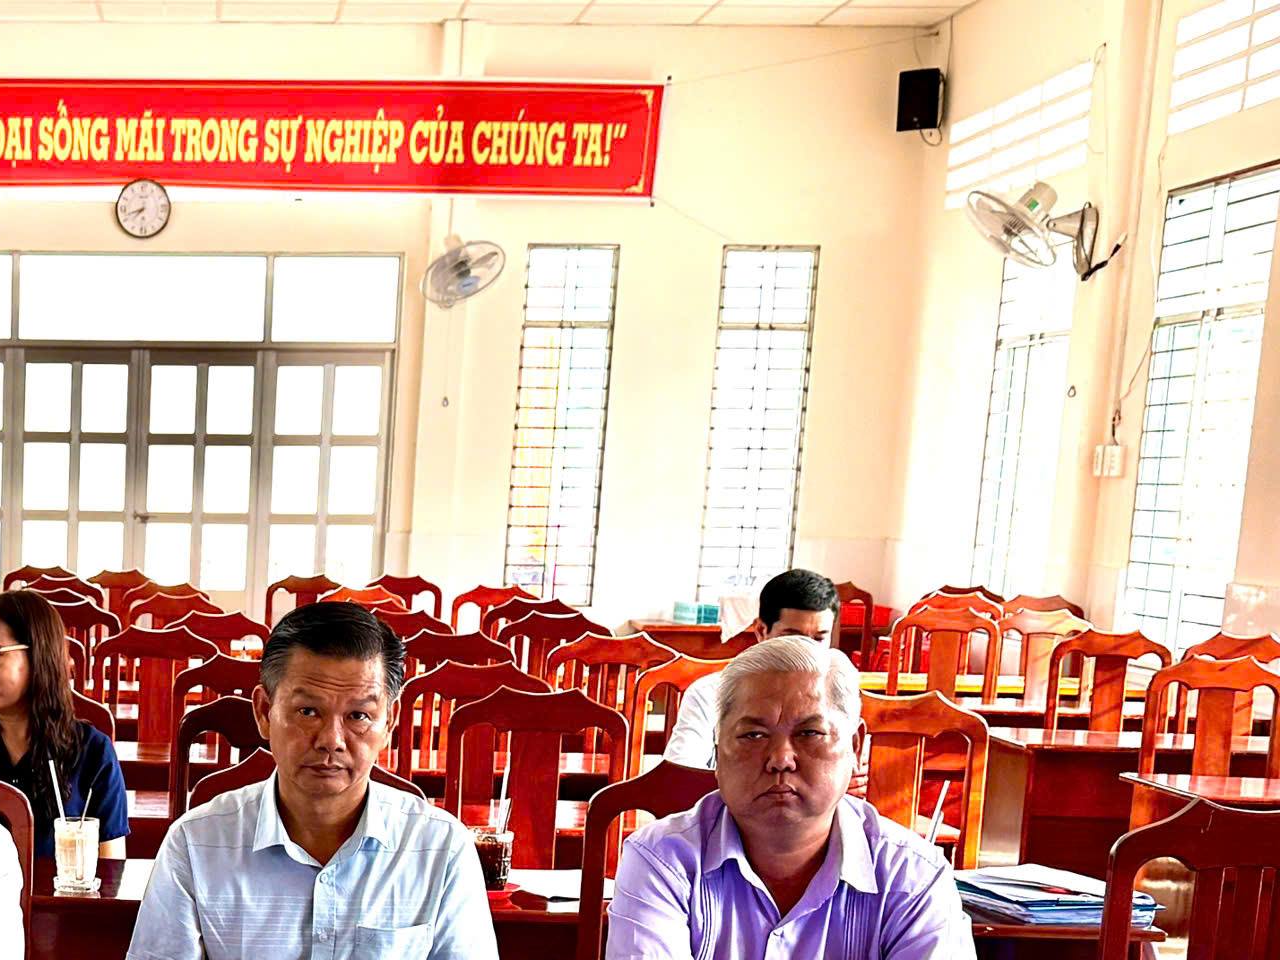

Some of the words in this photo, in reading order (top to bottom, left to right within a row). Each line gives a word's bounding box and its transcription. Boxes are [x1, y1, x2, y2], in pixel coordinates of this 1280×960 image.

[38, 98, 110, 161] SỐNG
[170, 118, 258, 163] TRONG
[263, 114, 303, 172] SỰ
[305, 108, 404, 173] NGHIỆP
[410, 105, 465, 165] CỦA
[471, 108, 566, 166] CHÚNG
